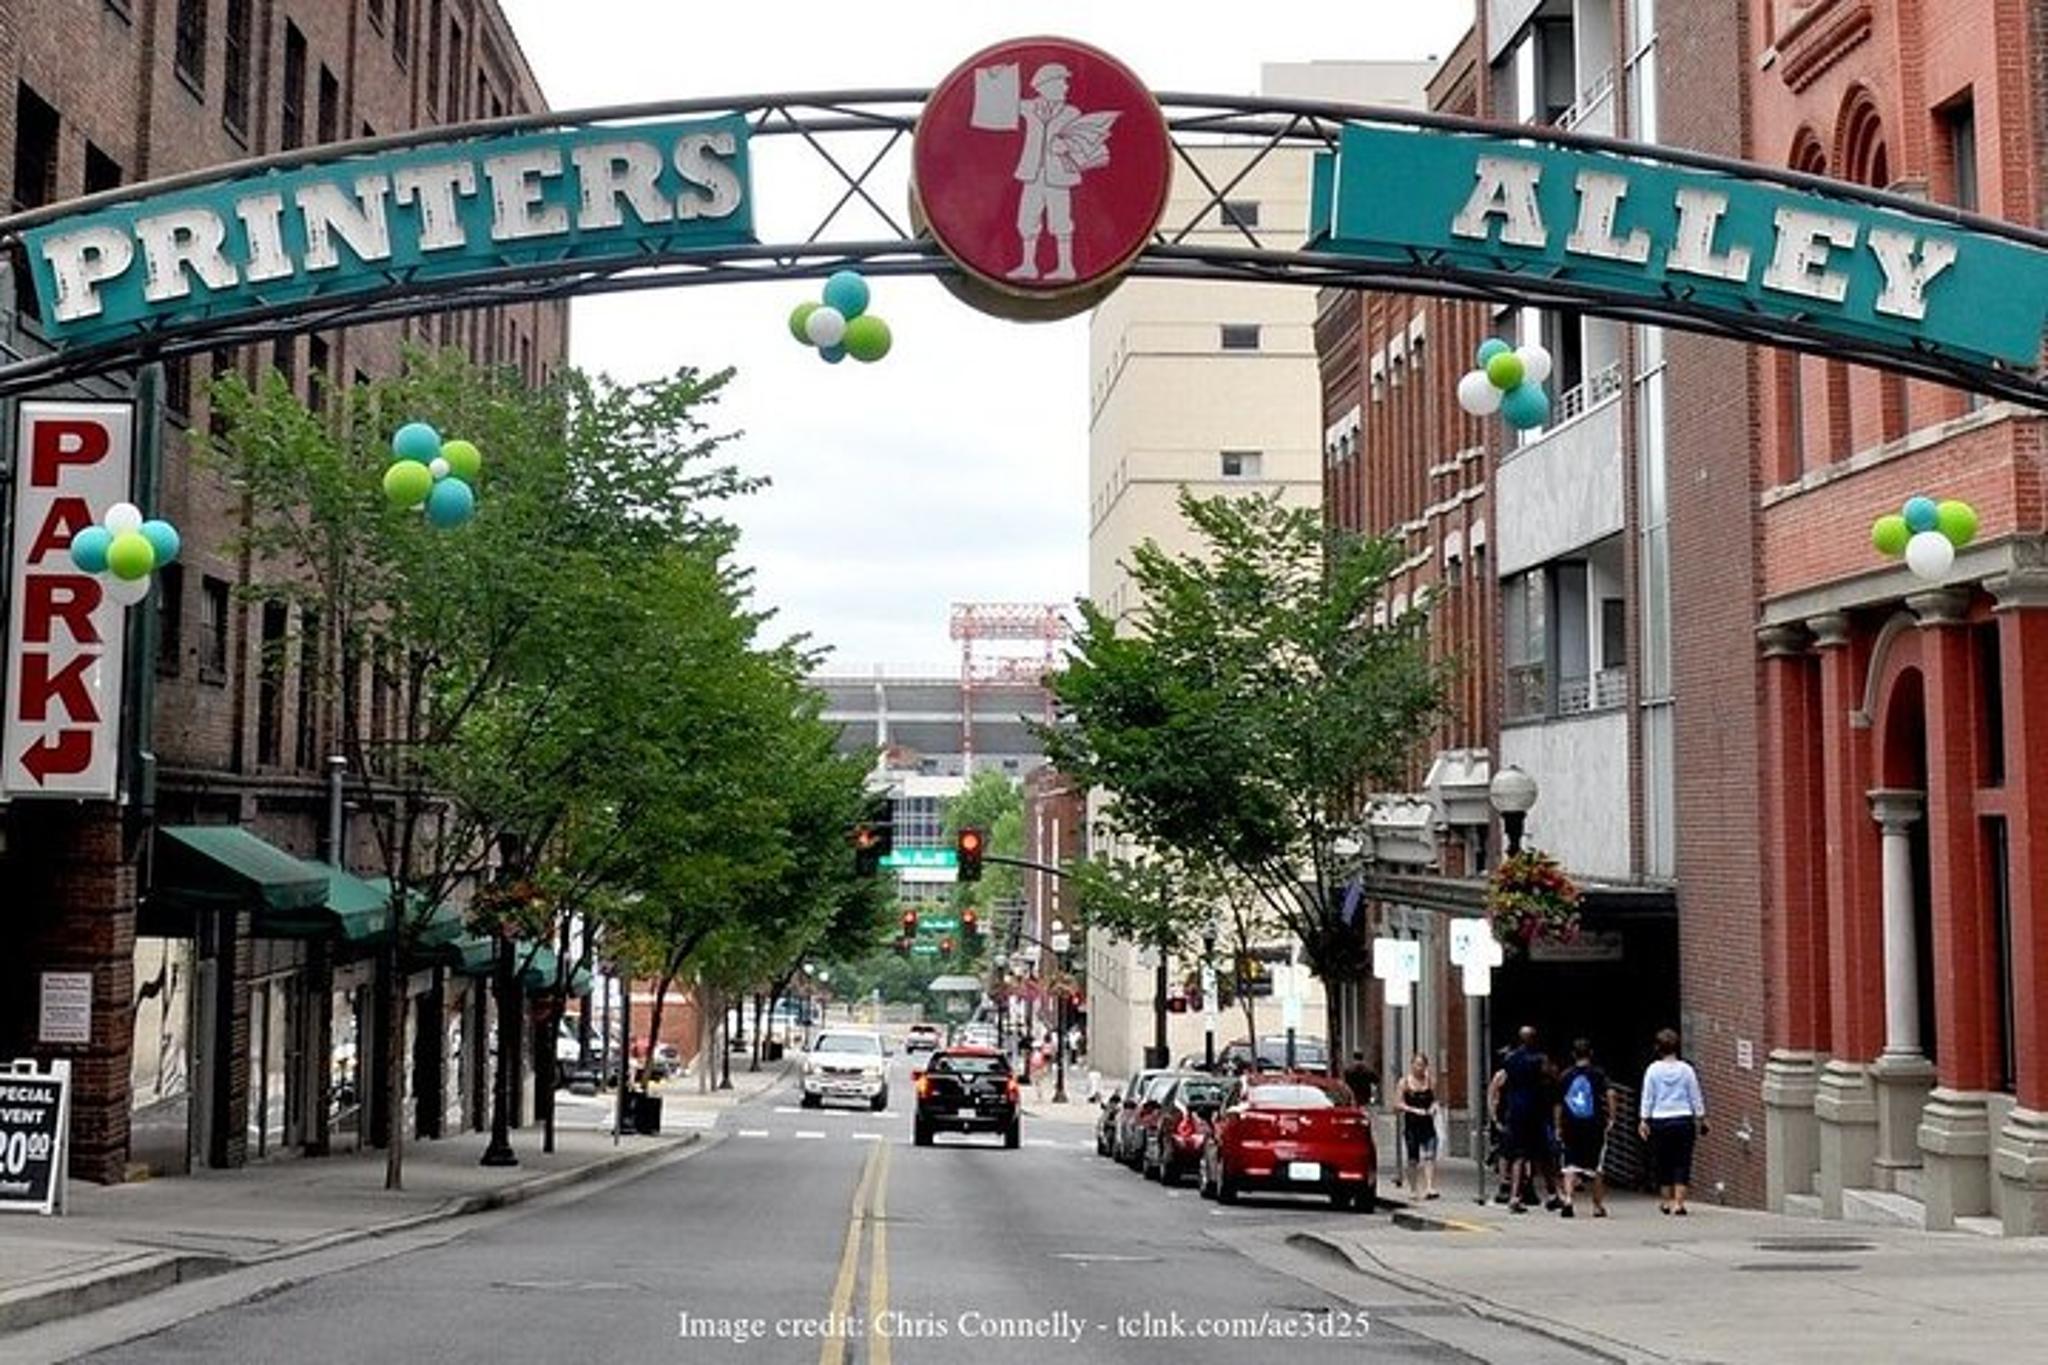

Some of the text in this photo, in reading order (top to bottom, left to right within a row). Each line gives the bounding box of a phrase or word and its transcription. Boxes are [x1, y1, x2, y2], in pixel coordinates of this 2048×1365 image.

[42, 131, 1958, 323] PRINTERS ALLEY
[19, 420, 110, 723] PARK
